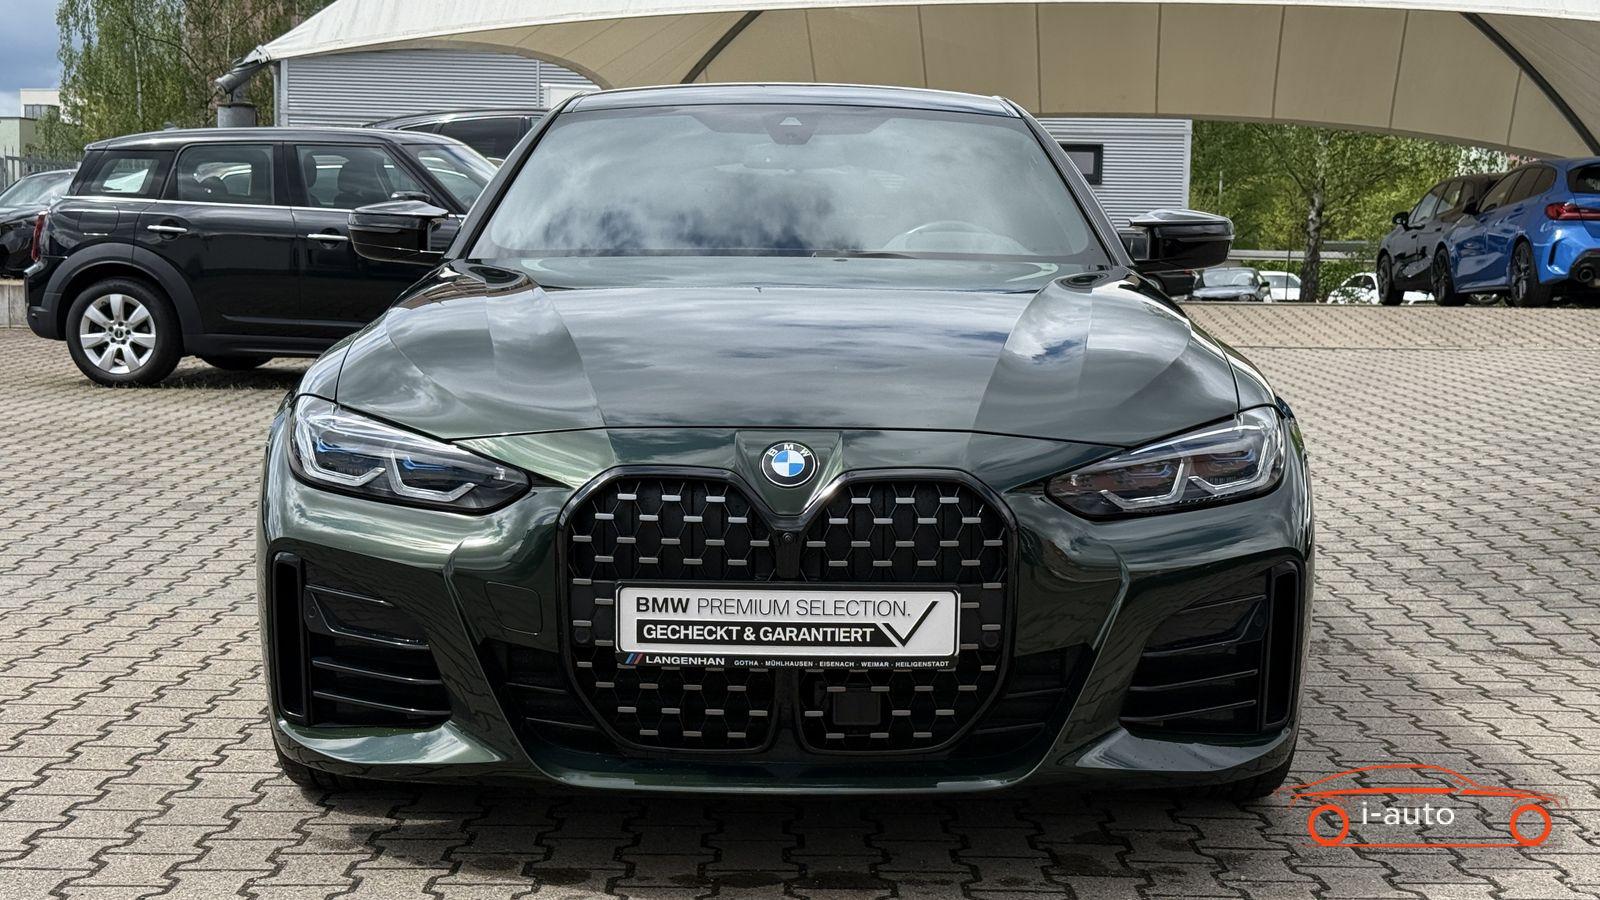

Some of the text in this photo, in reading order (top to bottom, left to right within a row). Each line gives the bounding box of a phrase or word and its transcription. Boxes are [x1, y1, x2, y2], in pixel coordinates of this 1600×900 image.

[767, 443, 810, 457] BMW
[636, 596, 911, 617] BMW PREMIUM SELECTION.
[643, 624, 875, 642] GECHECKT & GARANTIERT
[645, 656, 725, 666] LANGENHAN
[734, 659, 759, 667] GOTHA
[765, 659, 813, 668] MÜHLHAUSEN
[819, 660, 855, 668] EISENACH
[895, 660, 949, 668] HEILIGENSTADT
